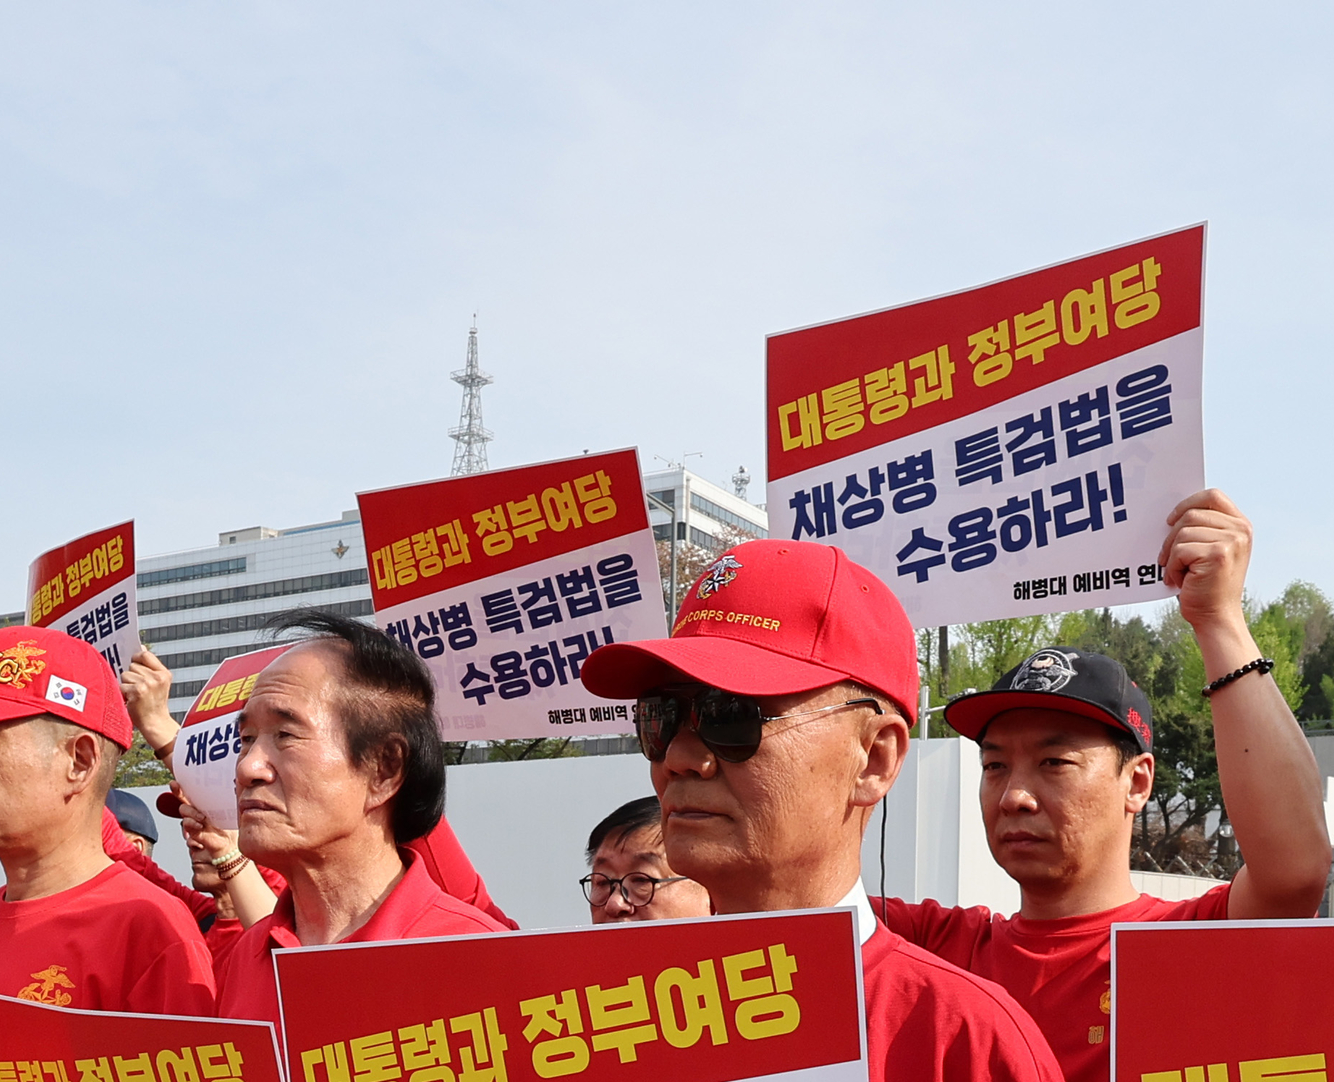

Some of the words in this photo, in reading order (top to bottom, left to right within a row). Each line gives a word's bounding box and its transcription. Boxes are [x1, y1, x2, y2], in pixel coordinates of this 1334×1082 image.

[778, 344, 956, 451] 대통령과
[968, 256, 1161, 387] 정부여당
[788, 448, 937, 540] 채상병
[954, 364, 1173, 487] 특검법을
[66, 535, 124, 598] 정부여당
[371, 519, 471, 590] 대통령과
[472, 470, 617, 557] 정부여당
[895, 462, 1127, 583] 수용하라!
[481, 553, 643, 634] 특검법을
[687, 609, 724, 623] CORPS
[726, 612, 781, 632] OFFICER
[1013, 576, 1067, 600] 해병대
[1073, 567, 1130, 593] 예비역
[548, 708, 586, 724] 해병대
[589, 705, 628, 722] 예비역
[520, 943, 801, 1079] 정부여당
